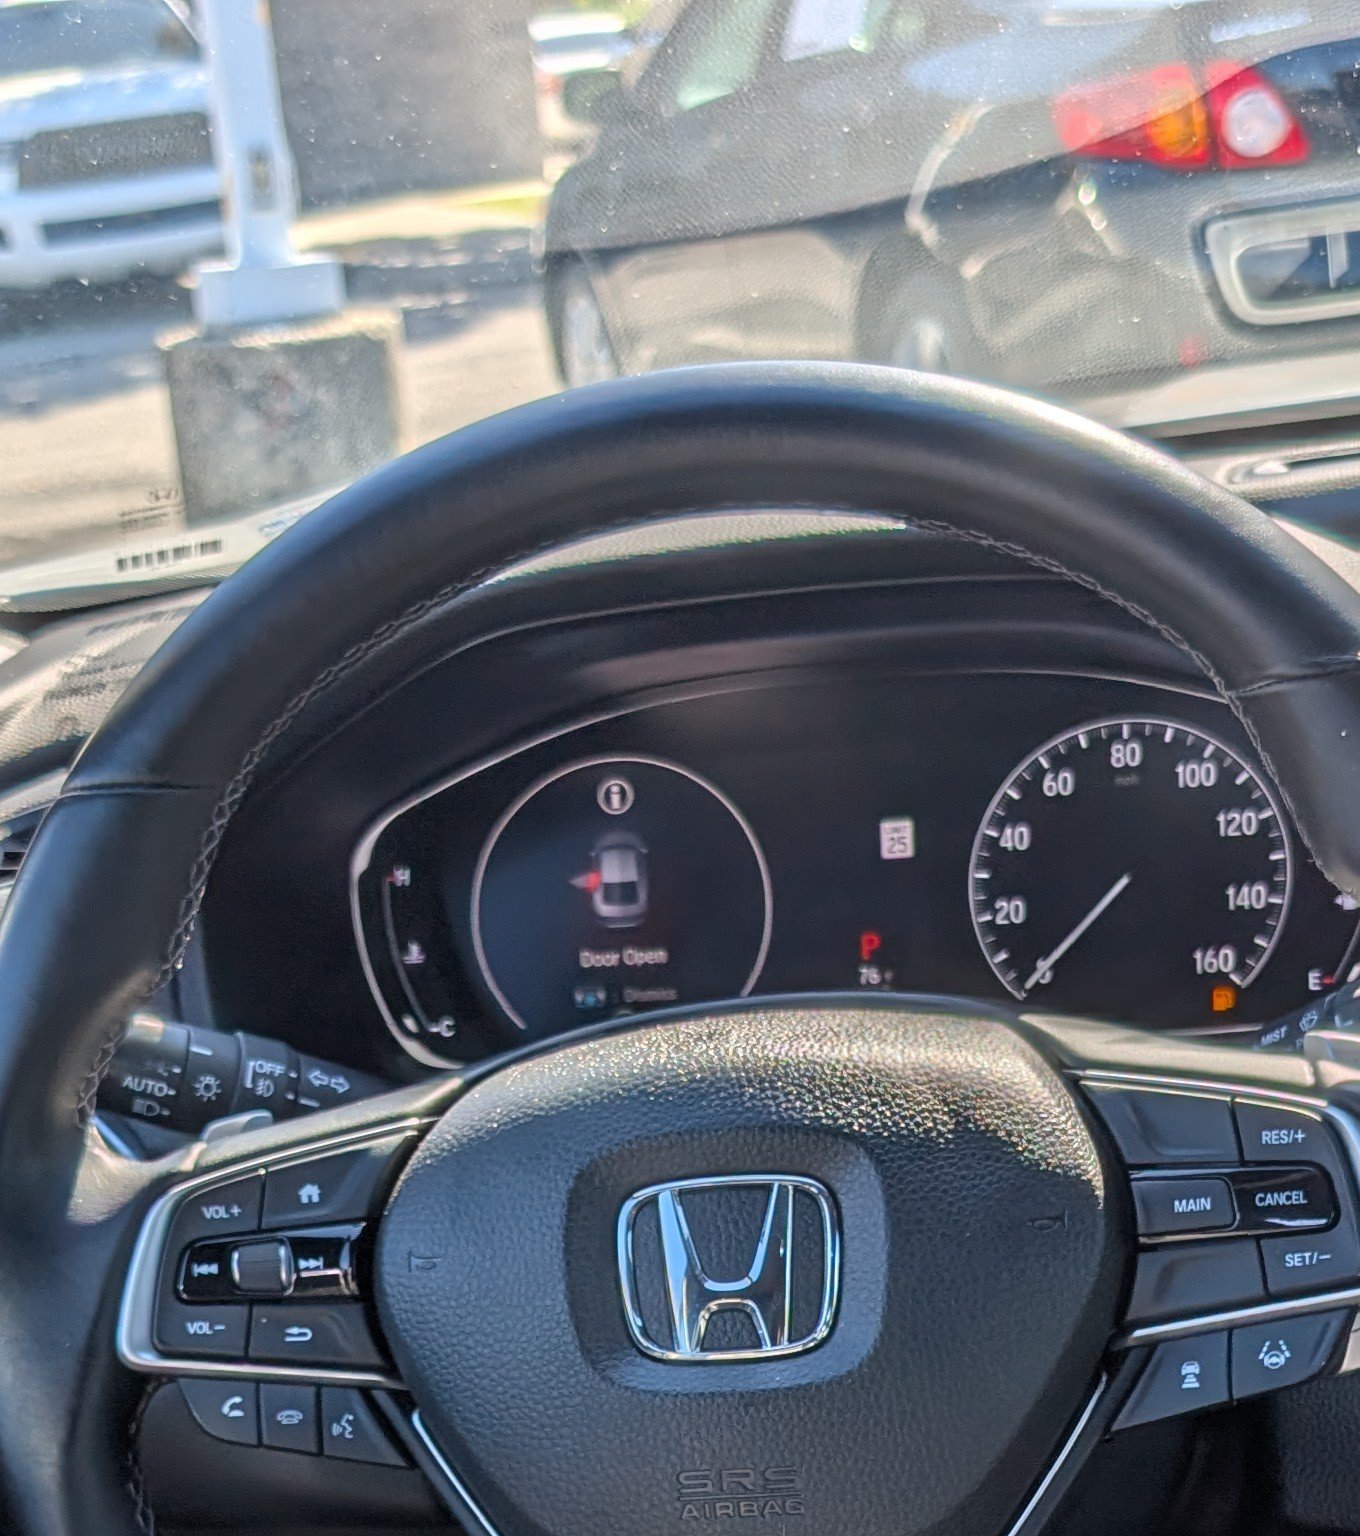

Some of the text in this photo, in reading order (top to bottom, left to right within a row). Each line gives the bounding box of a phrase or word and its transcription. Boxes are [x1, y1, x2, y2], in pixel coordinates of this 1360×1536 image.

[1110, 740, 1141, 768] 80
[1042, 768, 1075, 797] 60
[1175, 760, 1218, 788] 100
[1215, 810, 1258, 837] 120
[887, 836, 909, 855] 25
[999, 823, 1031, 851] 40
[1226, 882, 1268, 911] 140
[994, 896, 1027, 925] 20
[859, 931, 881, 960] P
[579, 947, 668, 969] Door Open
[1193, 945, 1236, 974] 160
[1308, 968, 1323, 991] E
[440, 1016, 456, 1037] C
[1260, 1025, 1288, 1047] MIST
[255, 1060, 286, 1078] OFF
[122, 1075, 168, 1097] AUTO
[1262, 1129, 1306, 1145] RES/+
[1173, 1197, 1211, 1213] MAIN
[1255, 1190, 1308, 1207] CANCEL
[676, 1466, 802, 1494] SRS
[681, 1500, 805, 1520] AIRBAG
